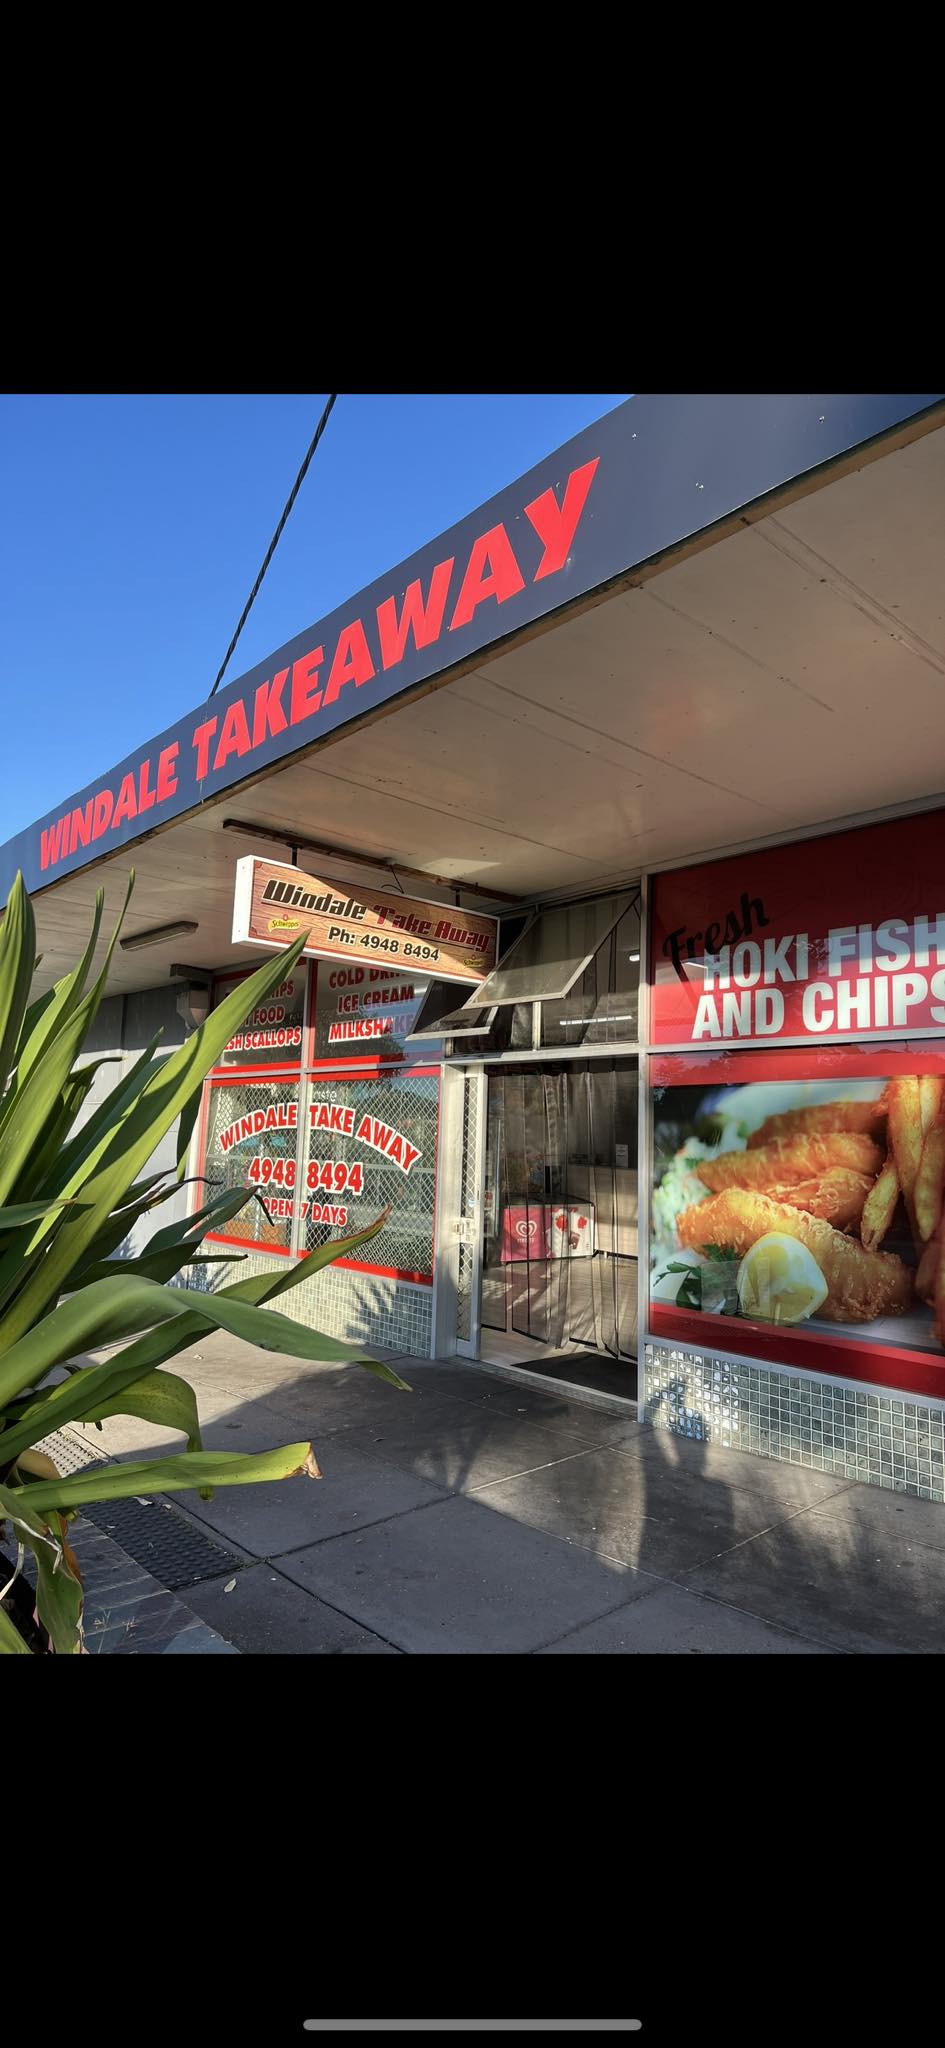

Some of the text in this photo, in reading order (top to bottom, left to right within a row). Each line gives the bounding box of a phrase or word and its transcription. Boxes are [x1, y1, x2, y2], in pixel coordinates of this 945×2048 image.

[40, 456, 600, 870] WINDALE TAKEAWAY
[262, 879, 491, 952] Windale Take Away
[662, 892, 769, 964] Fresh
[328, 927, 440, 961] Ph: 4948 8494
[704, 912, 945, 991] HOKI FISH
[329, 967, 364, 989] COLD
[253, 1005, 285, 1025] FOOD
[337, 983, 415, 1014] ICE CREAM
[691, 968, 945, 1039] AND CHIPS
[244, 1026, 302, 1051] SCALLOPS
[219, 1102, 423, 1174] WINDALE TAKE AWAY
[248, 1156, 364, 1195] 4948 8494
[261, 1197, 348, 1227] OPEN 7 DAYS
